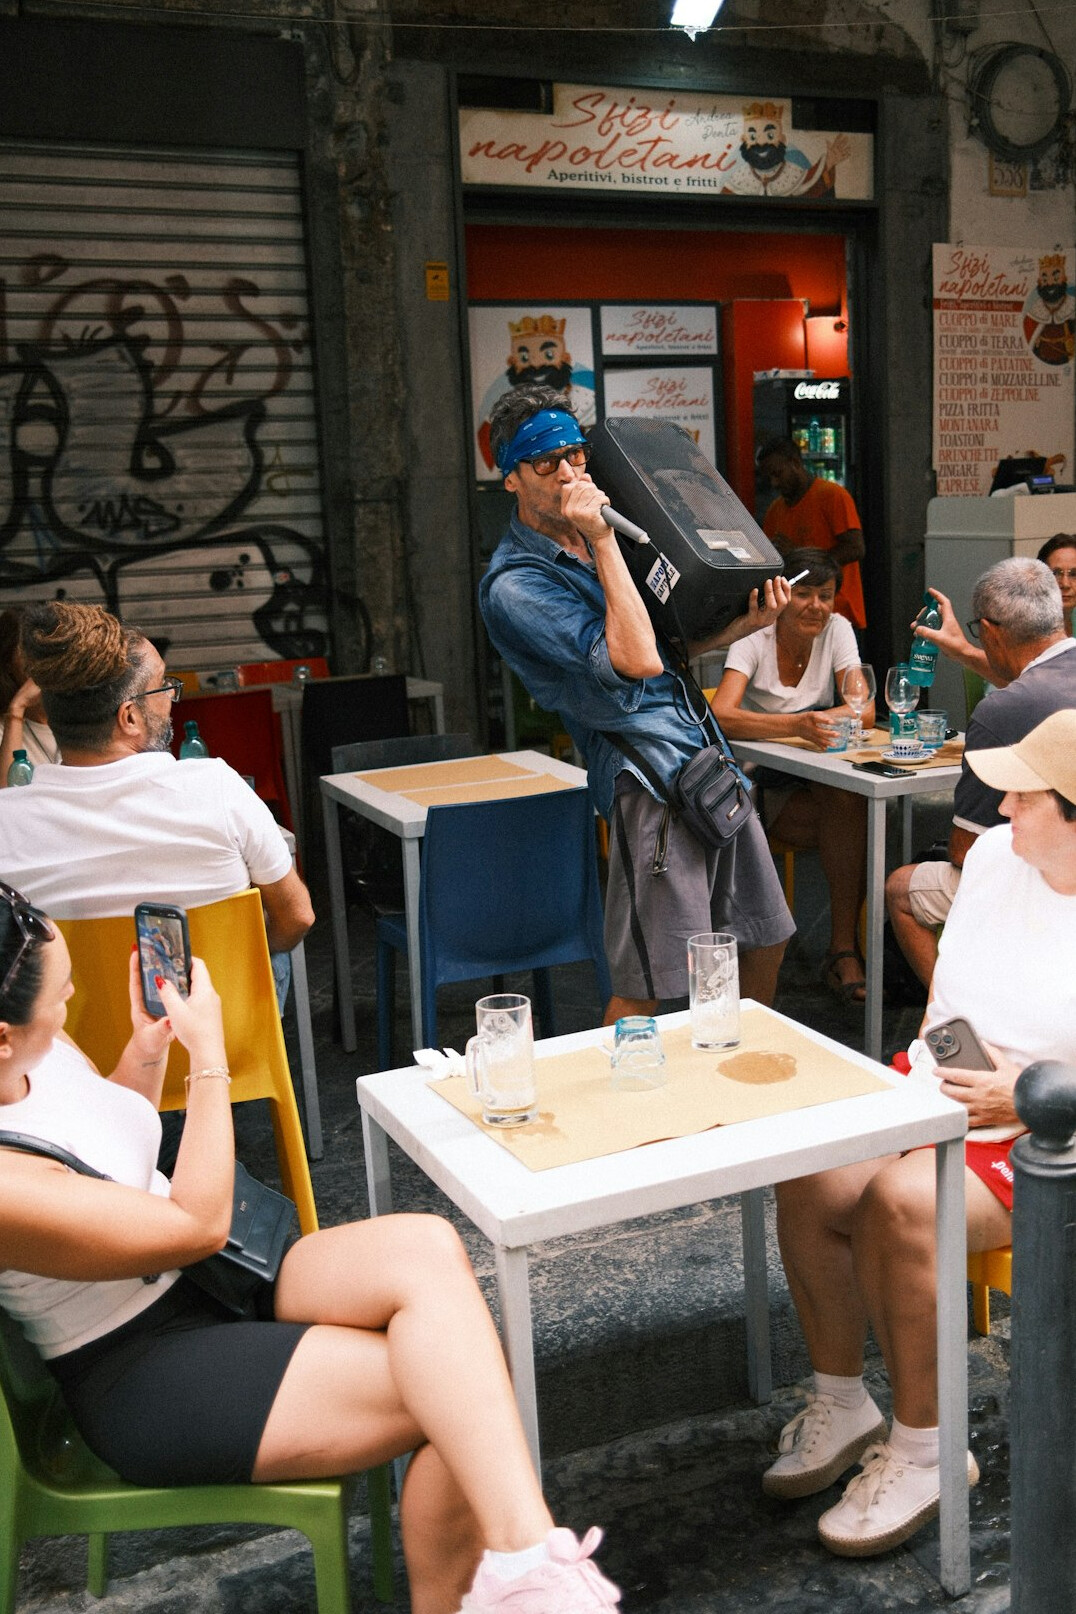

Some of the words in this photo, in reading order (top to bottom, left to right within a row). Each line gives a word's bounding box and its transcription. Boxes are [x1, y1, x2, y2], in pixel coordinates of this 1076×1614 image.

[551, 91, 680, 138] Sfizi
[468, 133, 738, 174] napoletani
[547, 169, 617, 184] Aperitivi,
[621, 173, 669, 185] bistrot
[674, 178, 682, 186] e
[686, 176, 718, 188] fritti
[944, 250, 990, 278] Sfizi
[938, 272, 1029, 300] napoletani
[624, 309, 677, 329] Sfizi
[991, 314, 1019, 328] MARE
[605, 327, 714, 346] napoletani
[939, 335, 977, 349] CUOPPO
[991, 336, 1024, 349] TERRA
[991, 358, 1035, 371] PATATINE
[641, 376, 688, 396] Sfizi
[991, 373, 1061, 387] MOZZARELLINE
[611, 393, 709, 412] napoletani
[939, 403, 964, 416] PIZZA
[967, 403, 1000, 416] FRITTA
[939, 418, 999, 432] MONTANARA
[939, 433, 985, 447] TOASTONI
[939, 448, 999, 462] BRUSCHETTE
[938, 463, 979, 477] ZINGARE
[937, 478, 981, 492] CAPRESE
